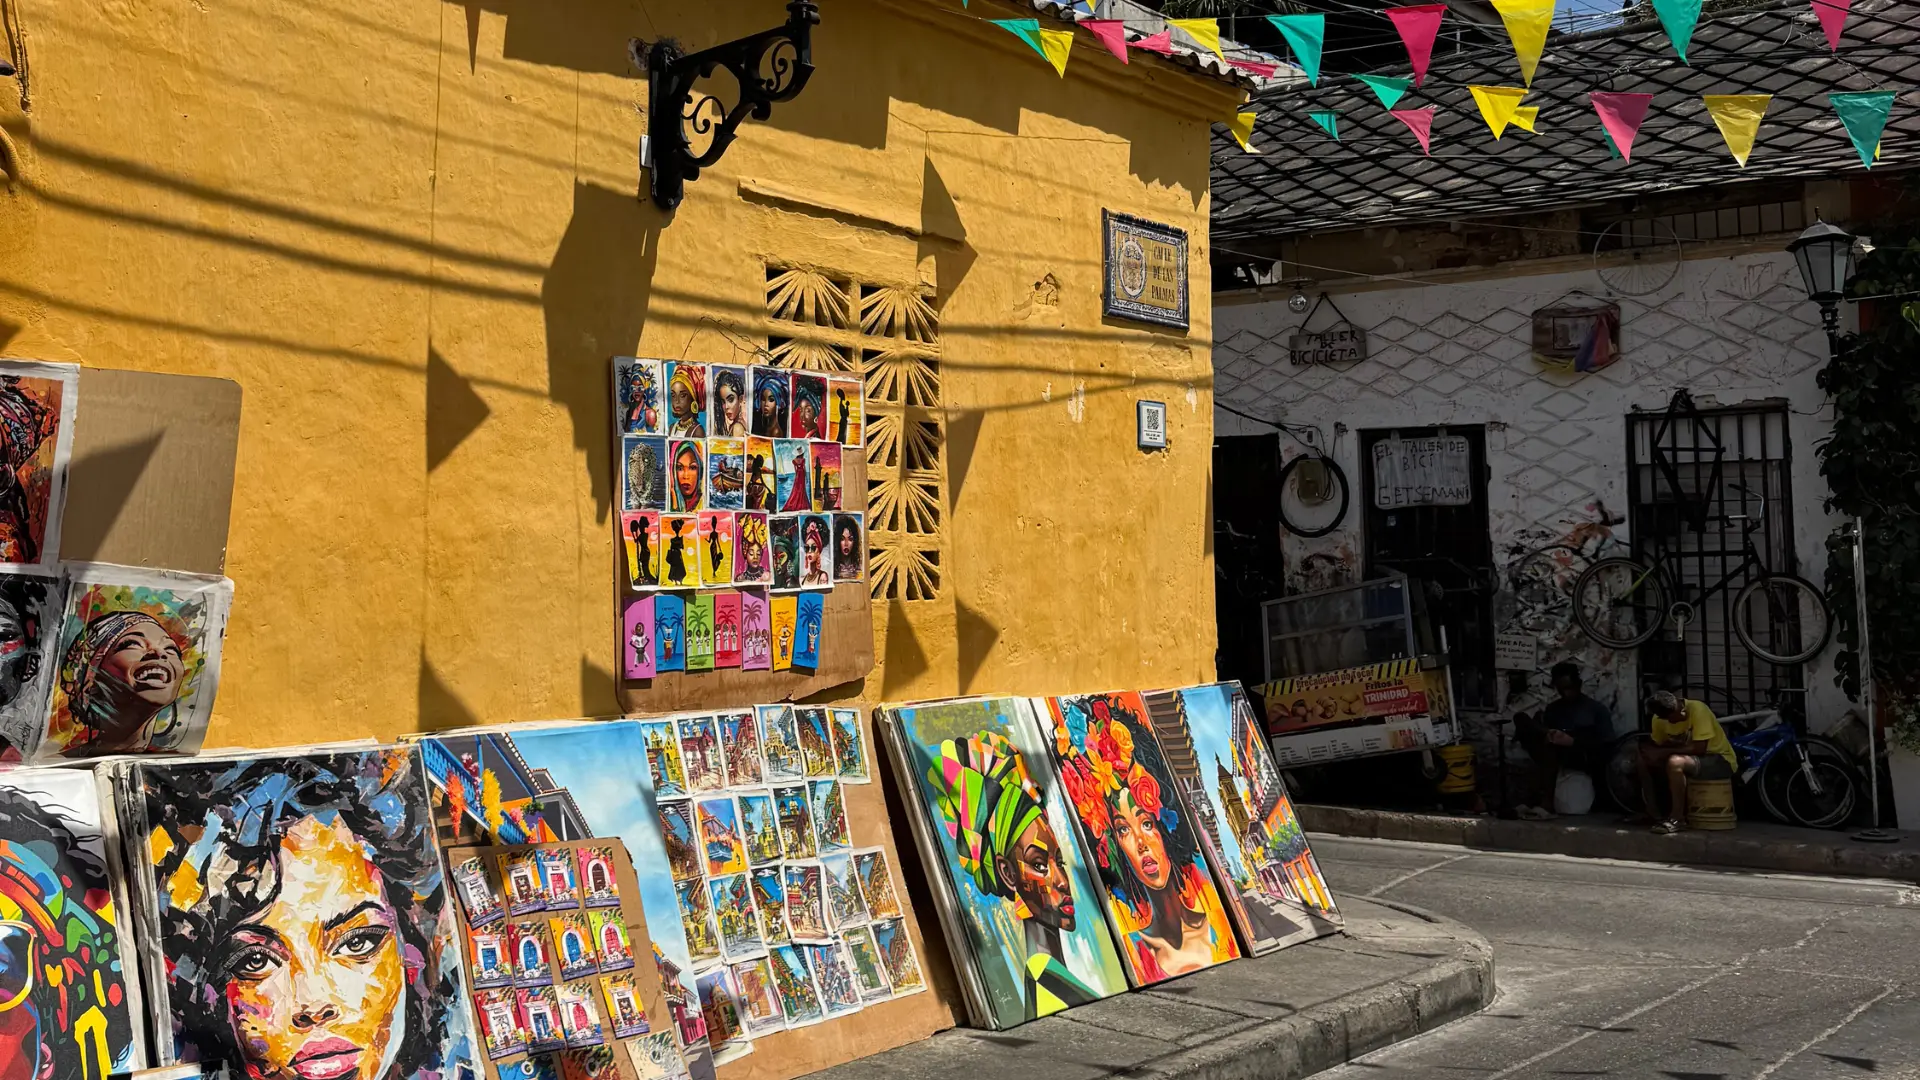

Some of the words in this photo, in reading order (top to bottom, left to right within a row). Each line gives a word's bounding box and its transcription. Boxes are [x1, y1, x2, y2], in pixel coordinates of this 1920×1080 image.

[1153, 245, 1172, 262] CALLE
[1152, 265, 1161, 280] DE
[1162, 267, 1174, 283] LAS
[1151, 284, 1175, 303] PALMAS
[1305, 330, 1359, 345] TALLER
[1320, 341, 1335, 349] DE
[1402, 440, 1443, 453] TALLER
[1449, 441, 1465, 453] DE
[1365, 680, 1392, 690] Fritos
[1393, 678, 1404, 686] la
[1364, 688, 1409, 704] TRINIDAD
